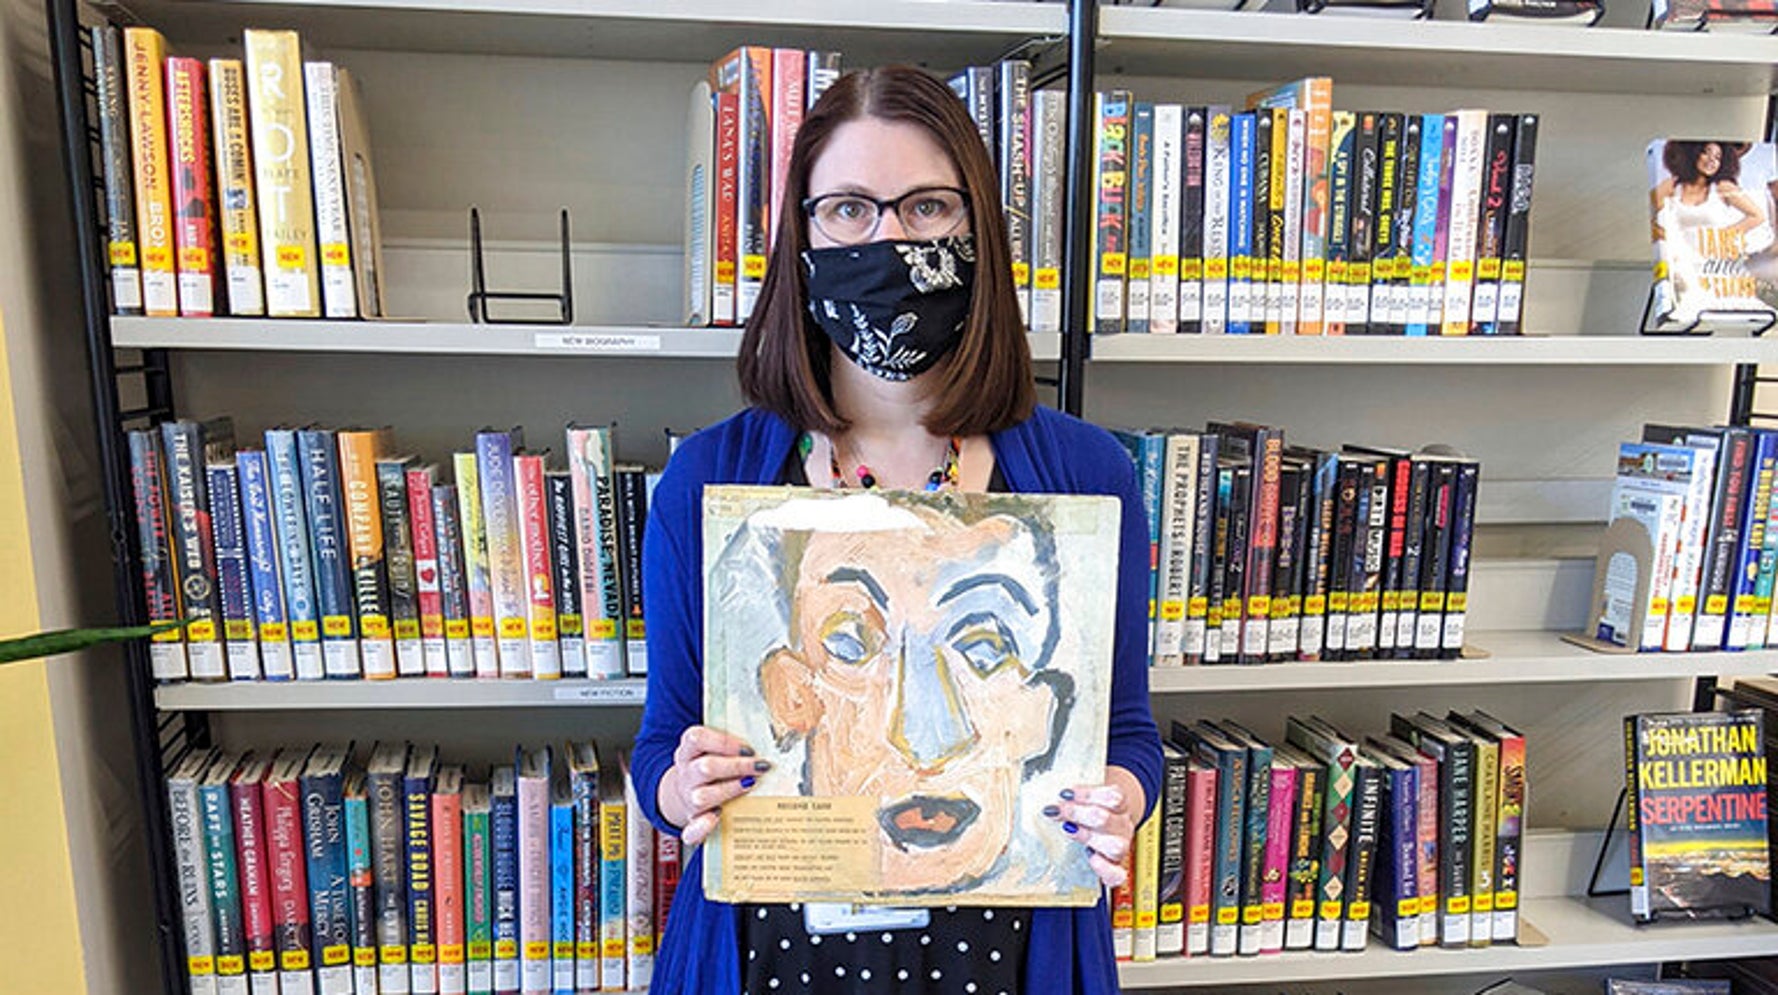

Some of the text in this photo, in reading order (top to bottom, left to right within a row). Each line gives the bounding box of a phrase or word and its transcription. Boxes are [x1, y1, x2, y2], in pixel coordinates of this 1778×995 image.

[223, 68, 237, 104] BUSES
[134, 43, 158, 190] JENNY LAWSON
[175, 70, 195, 163] AFTERSHOCKS
[227, 108, 241, 129] ARE
[722, 106, 735, 161] LANA'S
[1011, 77, 1027, 206] THE SMASH-UP
[1209, 218, 1223, 259] RISIN
[1263, 438, 1281, 482] BLOOD
[174, 433, 201, 569] THE KAISER'S WEB
[310, 449, 336, 560] HALF LIFE
[1170, 446, 1190, 538] THE PROPHETS
[356, 569, 380, 615] KILLE
[1646, 725, 1758, 756] JONATHAN
[1451, 751, 1468, 844] JANE HARPER
[1639, 757, 1768, 790] KELLERMAN
[206, 792, 222, 831] RAFT
[306, 793, 324, 858] GRISHAM
[324, 804, 341, 843] JOHN
[376, 782, 397, 882] JOHN HART
[1358, 778, 1378, 843] INFINITE
[1641, 793, 1769, 825] SERPENTINE
[239, 798, 258, 896] HEATHER GRAHAM
[407, 794, 430, 890] SAVAGE ROAD
[211, 851, 228, 899] STARS
[312, 890, 330, 938] MERCY
[333, 923, 347, 944] FO
